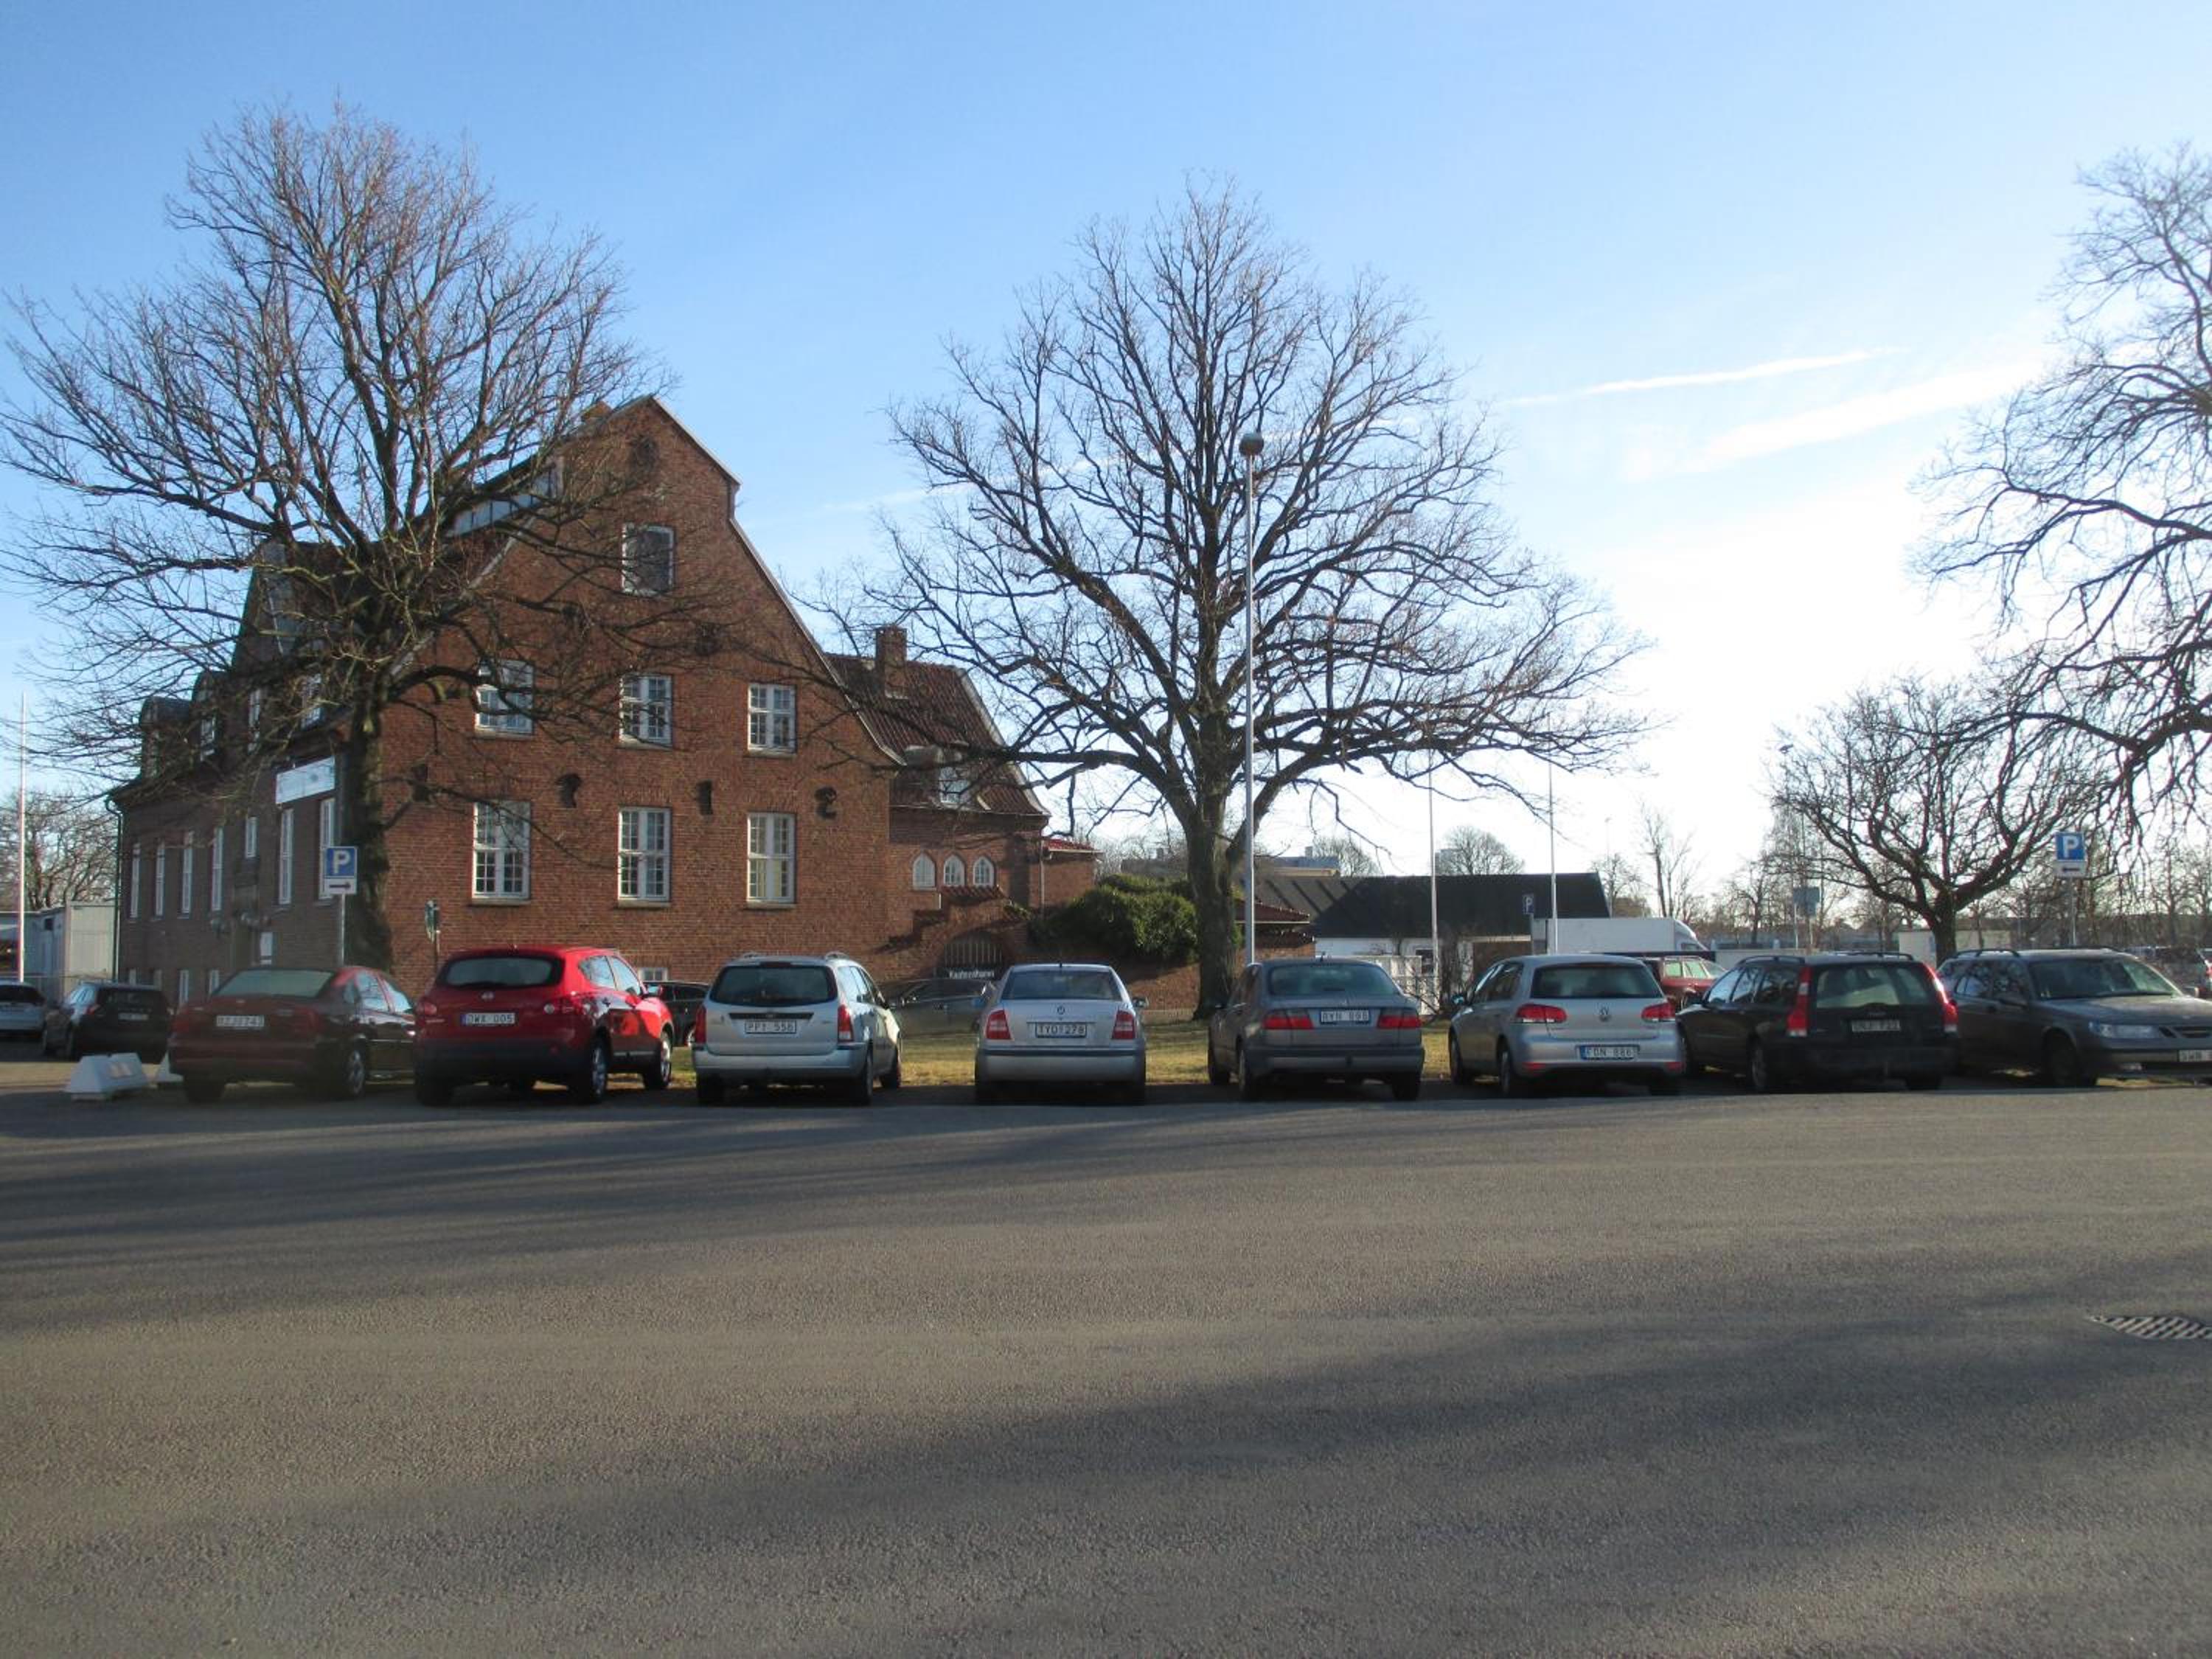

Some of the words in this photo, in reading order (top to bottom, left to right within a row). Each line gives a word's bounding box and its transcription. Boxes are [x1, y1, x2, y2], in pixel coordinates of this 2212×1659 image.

[2062, 835, 2079, 858] P
[333, 850, 351, 874] P
[1526, 897, 1533, 911] P
